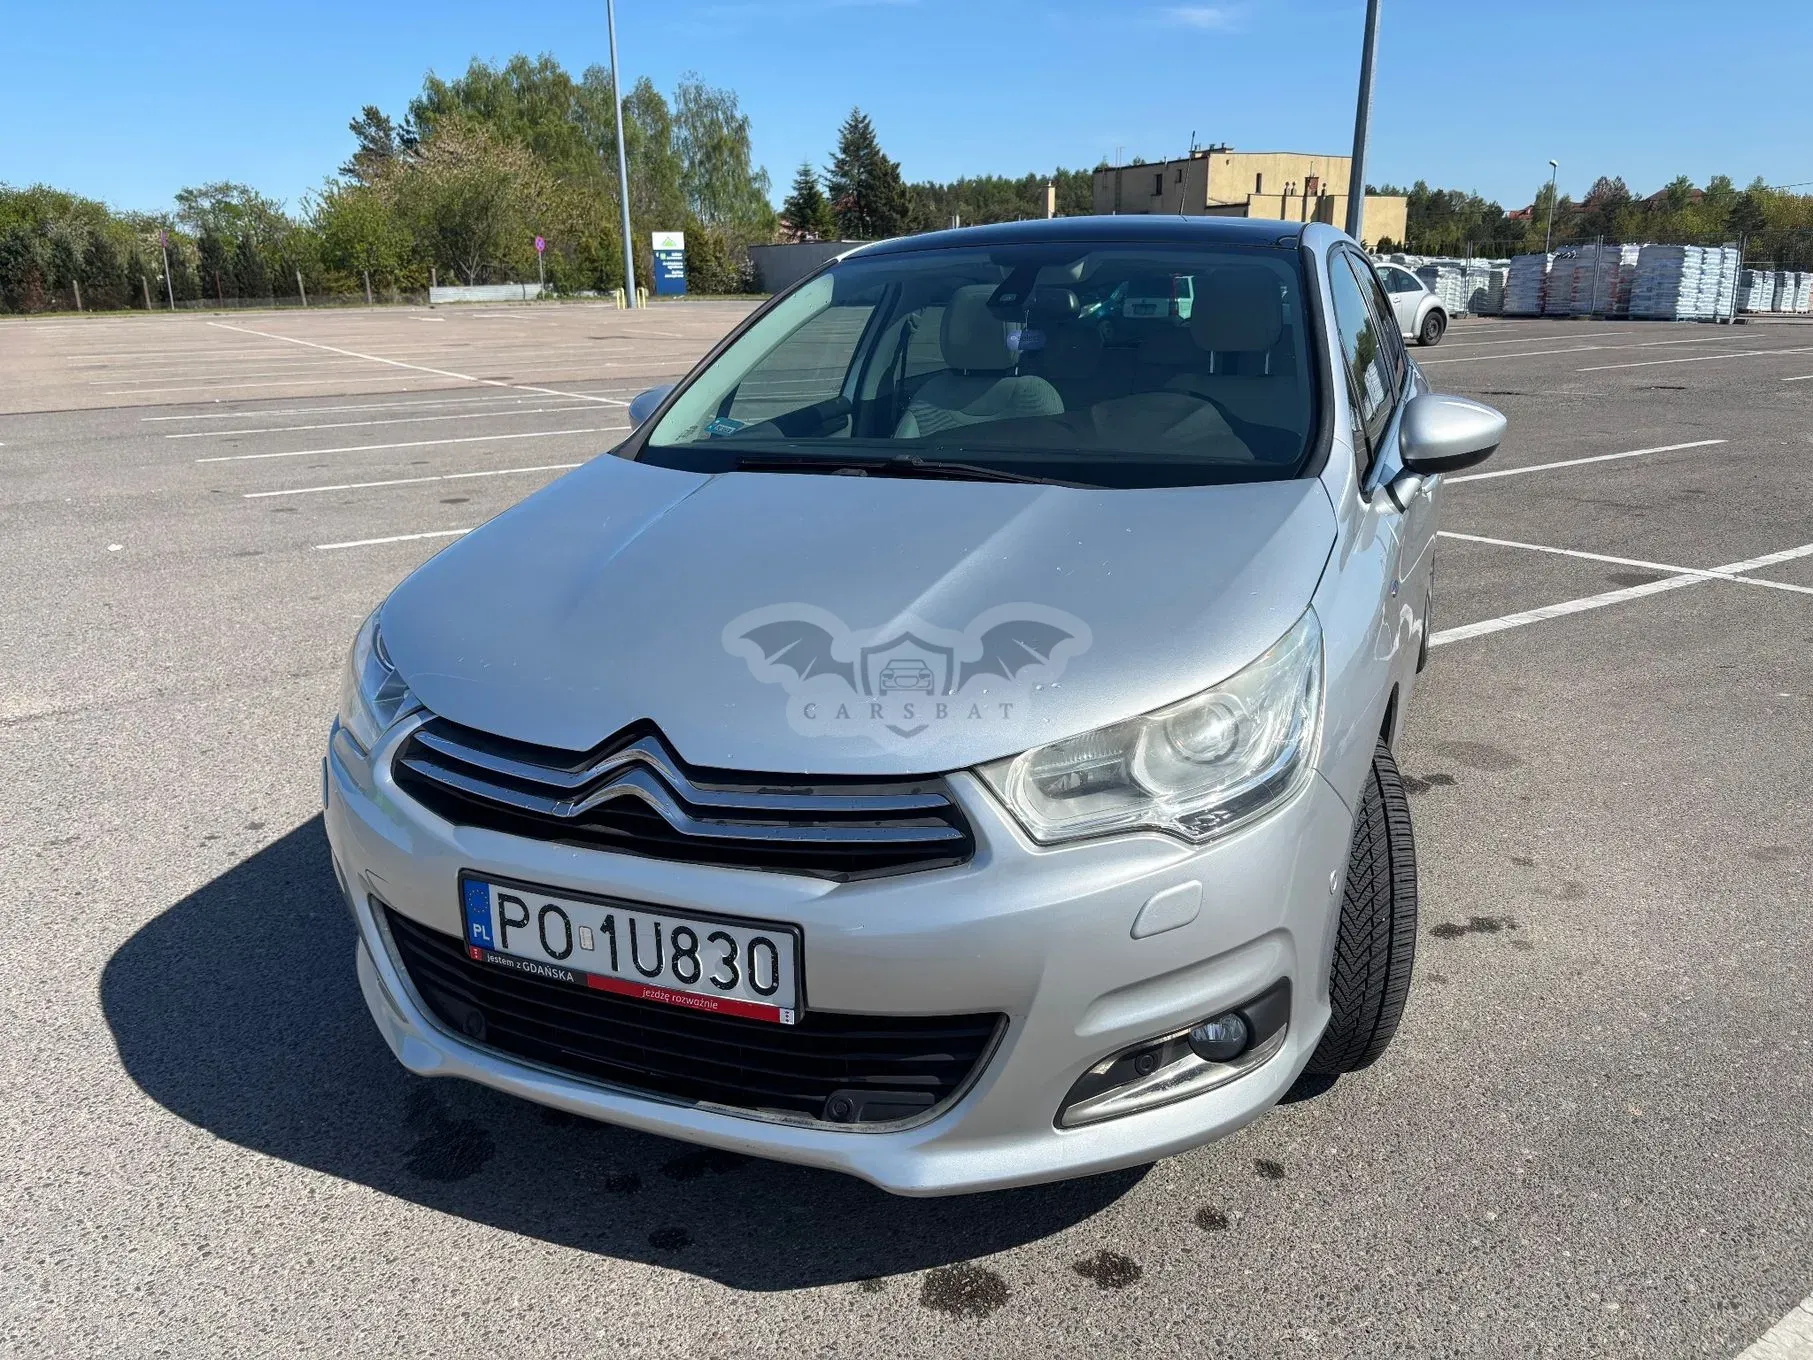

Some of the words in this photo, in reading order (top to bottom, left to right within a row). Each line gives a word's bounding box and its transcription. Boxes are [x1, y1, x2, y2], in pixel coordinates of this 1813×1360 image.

[473, 923, 491, 941] PL
[497, 892, 573, 961] PO
[600, 914, 780, 997] 1U830
[487, 952, 515, 967] jestem
[516, 961, 521, 969] z
[522, 961, 575, 983] GDAŃSKA
